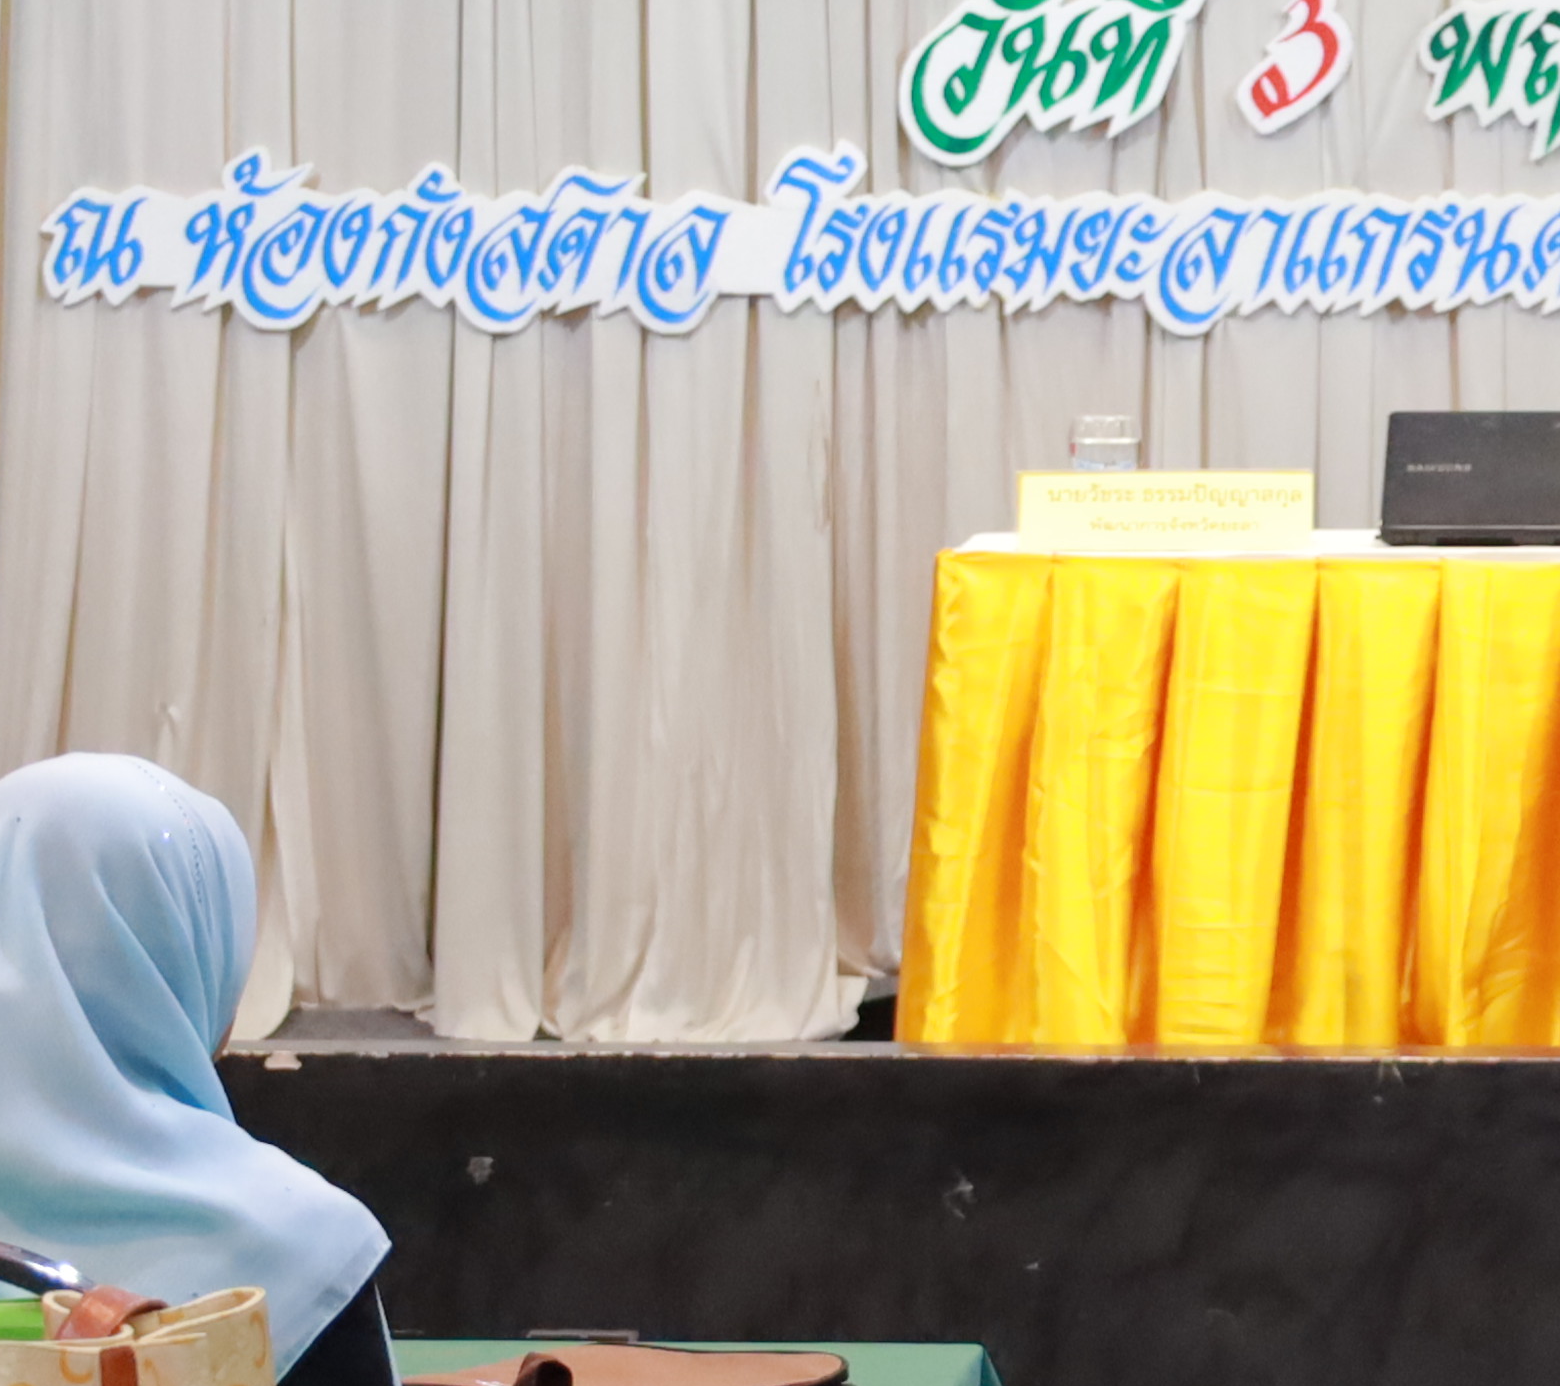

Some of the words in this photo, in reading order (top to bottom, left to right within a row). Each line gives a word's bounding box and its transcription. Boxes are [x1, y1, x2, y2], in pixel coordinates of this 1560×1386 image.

[52, 197, 148, 286] ณ
[184, 153, 731, 324] ห้องกังสดาล
